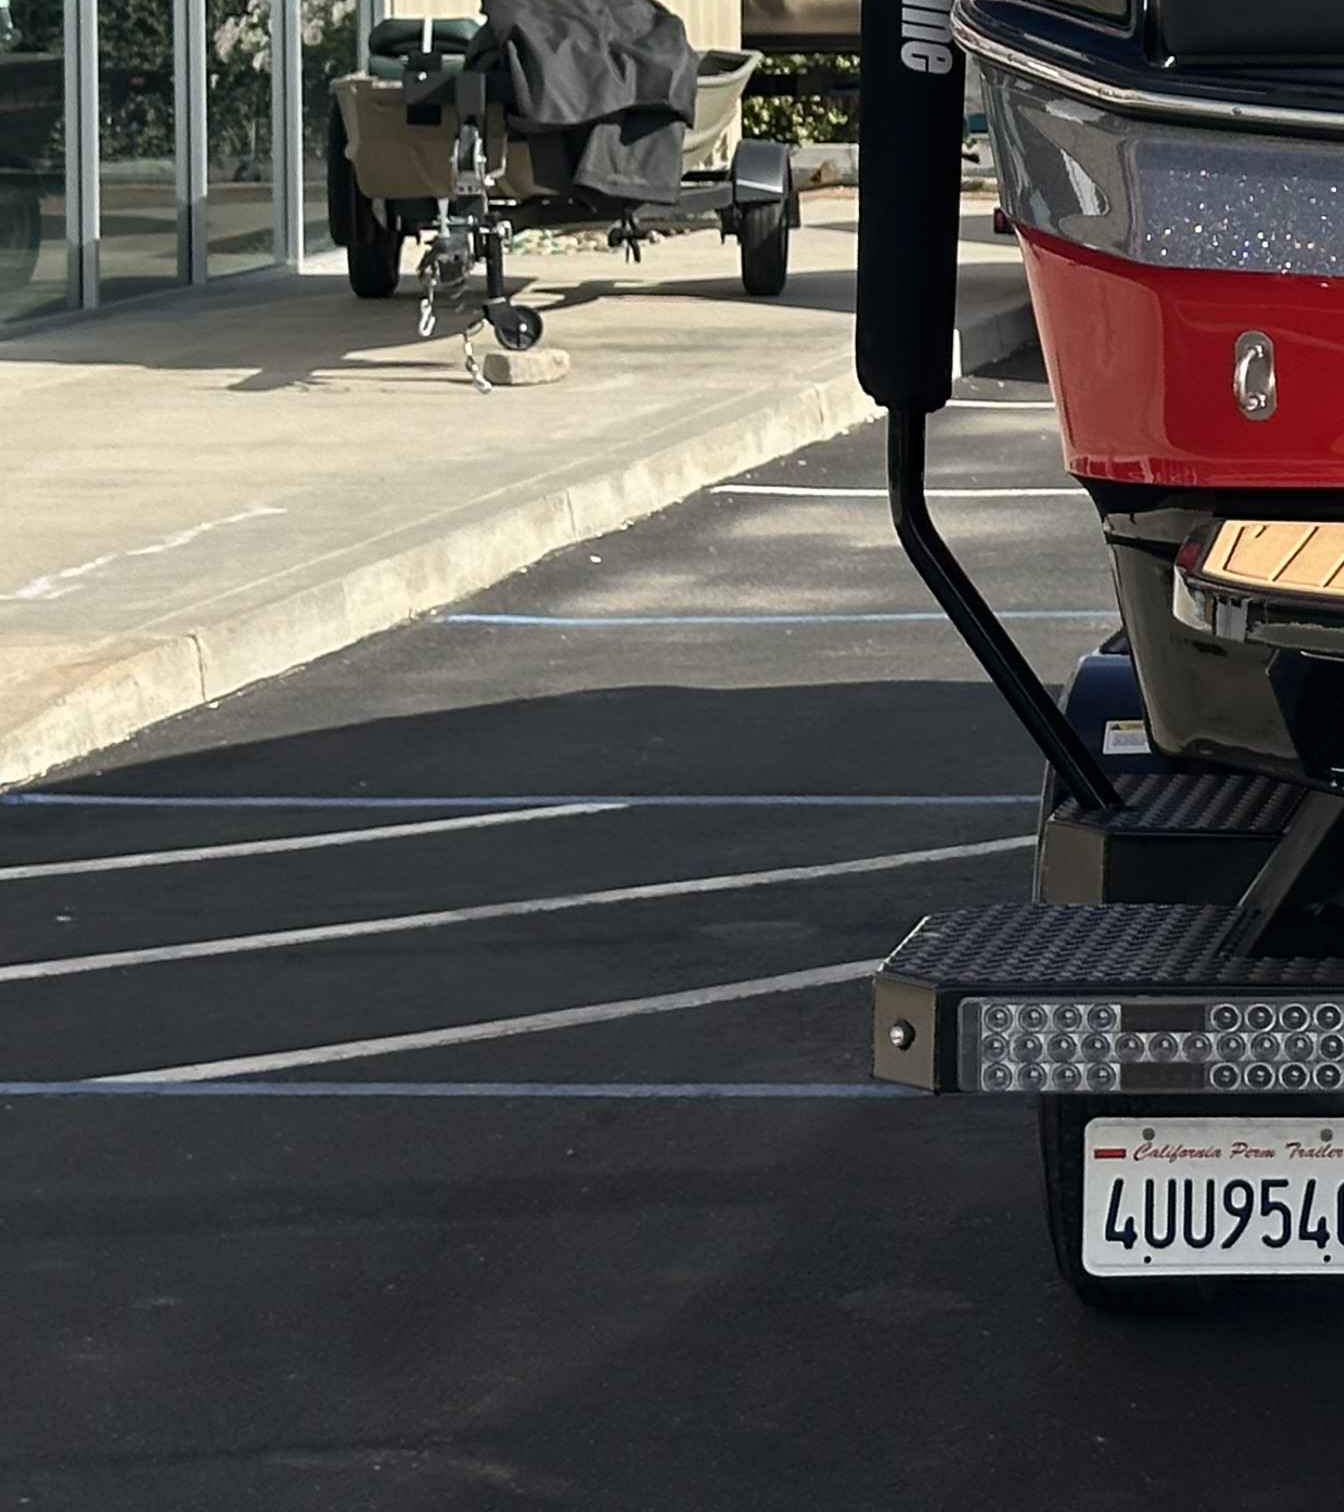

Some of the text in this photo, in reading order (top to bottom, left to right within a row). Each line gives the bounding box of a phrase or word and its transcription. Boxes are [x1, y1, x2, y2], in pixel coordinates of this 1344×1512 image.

[1133, 1141, 1344, 1163] California Perm Trailer
